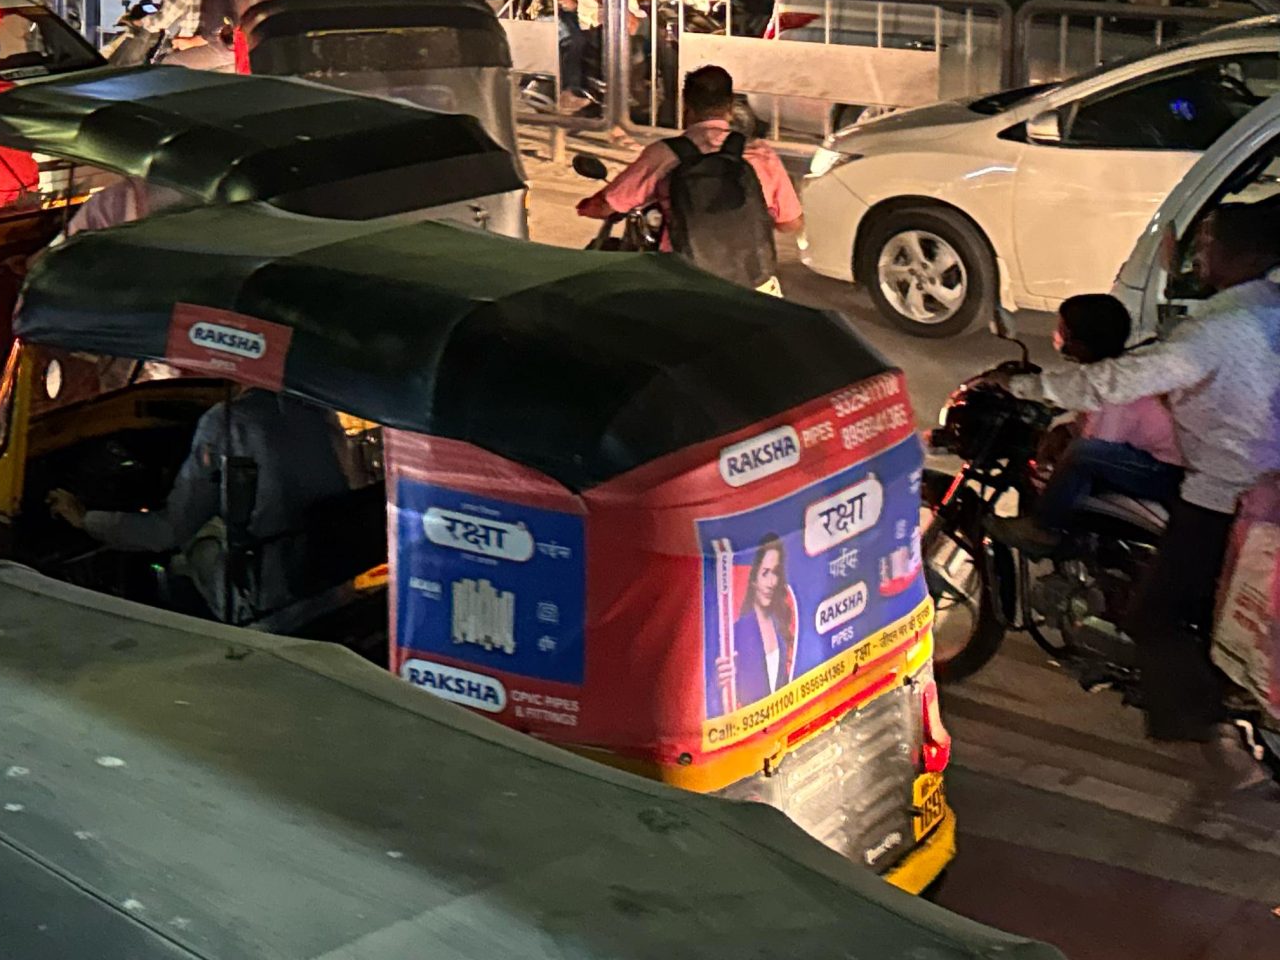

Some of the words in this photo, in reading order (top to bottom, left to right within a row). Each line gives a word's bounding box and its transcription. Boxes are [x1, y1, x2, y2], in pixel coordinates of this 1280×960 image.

[194, 327, 261, 354] RAKSHA
[727, 435, 797, 477] RAKSHA
[441, 514, 508, 551] रक्षा
[818, 491, 867, 537] रक्षा
[819, 590, 864, 627] RAKSHA
[408, 666, 501, 705] RAKSHA
